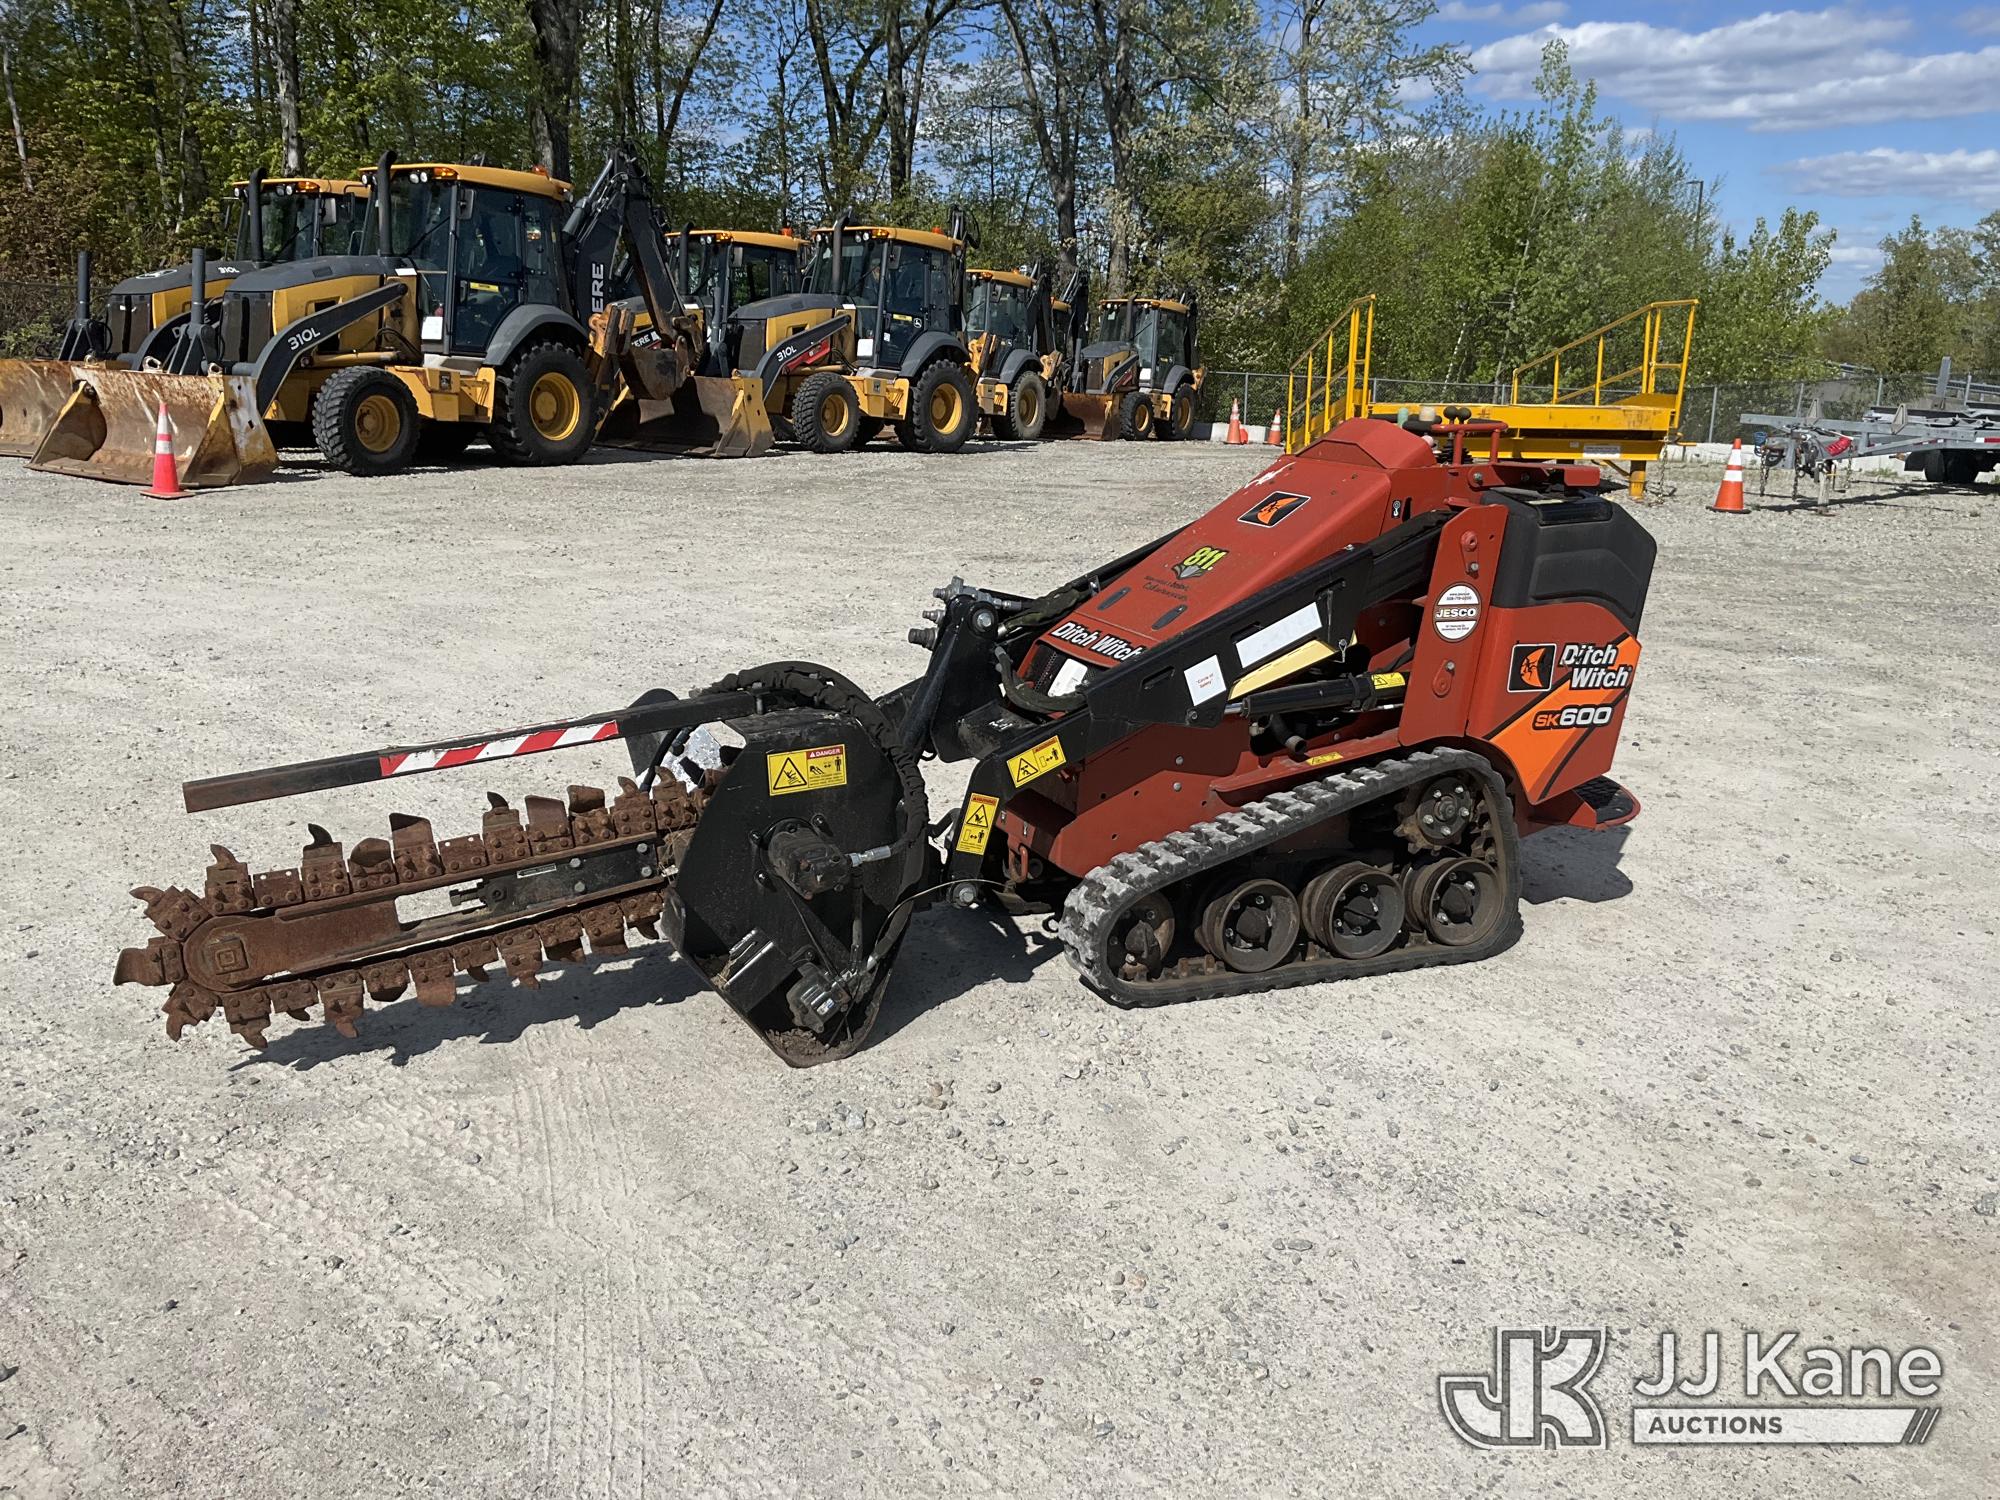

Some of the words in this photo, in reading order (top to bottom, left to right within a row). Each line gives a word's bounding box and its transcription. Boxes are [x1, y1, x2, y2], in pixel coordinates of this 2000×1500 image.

[591, 262, 604, 313] ERE
[287, 327, 322, 351] 310L
[631, 334, 652, 348] ERE
[776, 345, 798, 362] 310L
[1435, 607, 1477, 618] JESCO
[1051, 621, 1099, 647] Ditch
[1559, 644, 1619, 666] Ditch
[1571, 666, 1630, 688] Witch
[1534, 706, 1612, 728] SK600
[815, 748, 841, 758] DANGER
